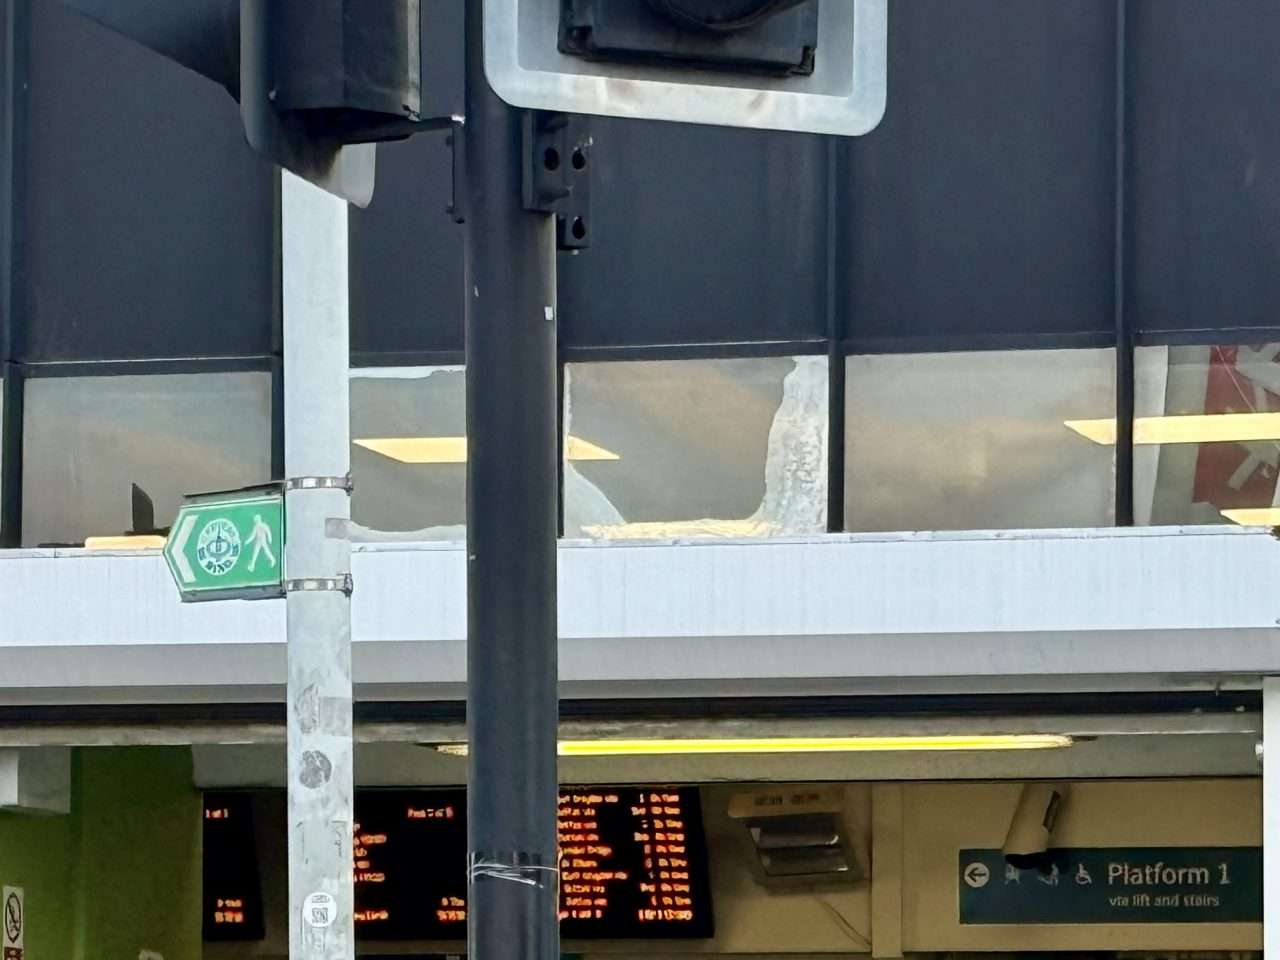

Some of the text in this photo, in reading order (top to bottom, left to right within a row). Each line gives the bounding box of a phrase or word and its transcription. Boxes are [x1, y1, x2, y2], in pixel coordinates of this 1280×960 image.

[1107, 861, 1231, 885] Platform 1
[1132, 893, 1151, 906] lift
[1153, 893, 1180, 906] and
